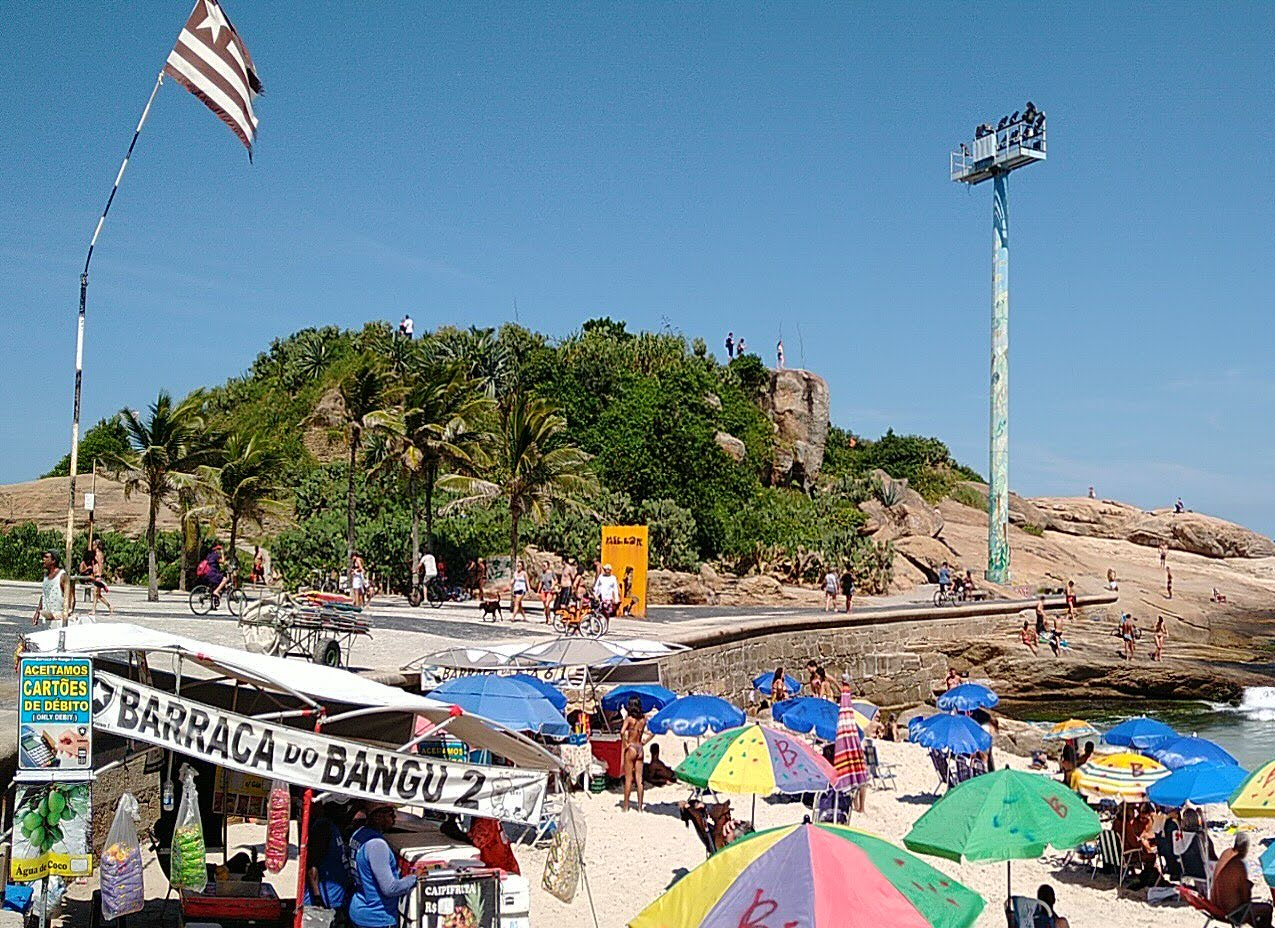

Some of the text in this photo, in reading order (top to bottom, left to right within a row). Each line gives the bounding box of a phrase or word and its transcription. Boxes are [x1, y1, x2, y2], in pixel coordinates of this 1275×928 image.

[24, 665, 88, 675] ACEITAMOS
[23, 678, 87, 696] CARTÕES
[24, 697, 89, 711] DE DÉBITO
[117, 685, 486, 811] BARRACA DO BANGU 2
[774, 739, 798, 770] B
[15, 860, 68, 877] Água de Coco
[424, 901, 438, 914] R$
